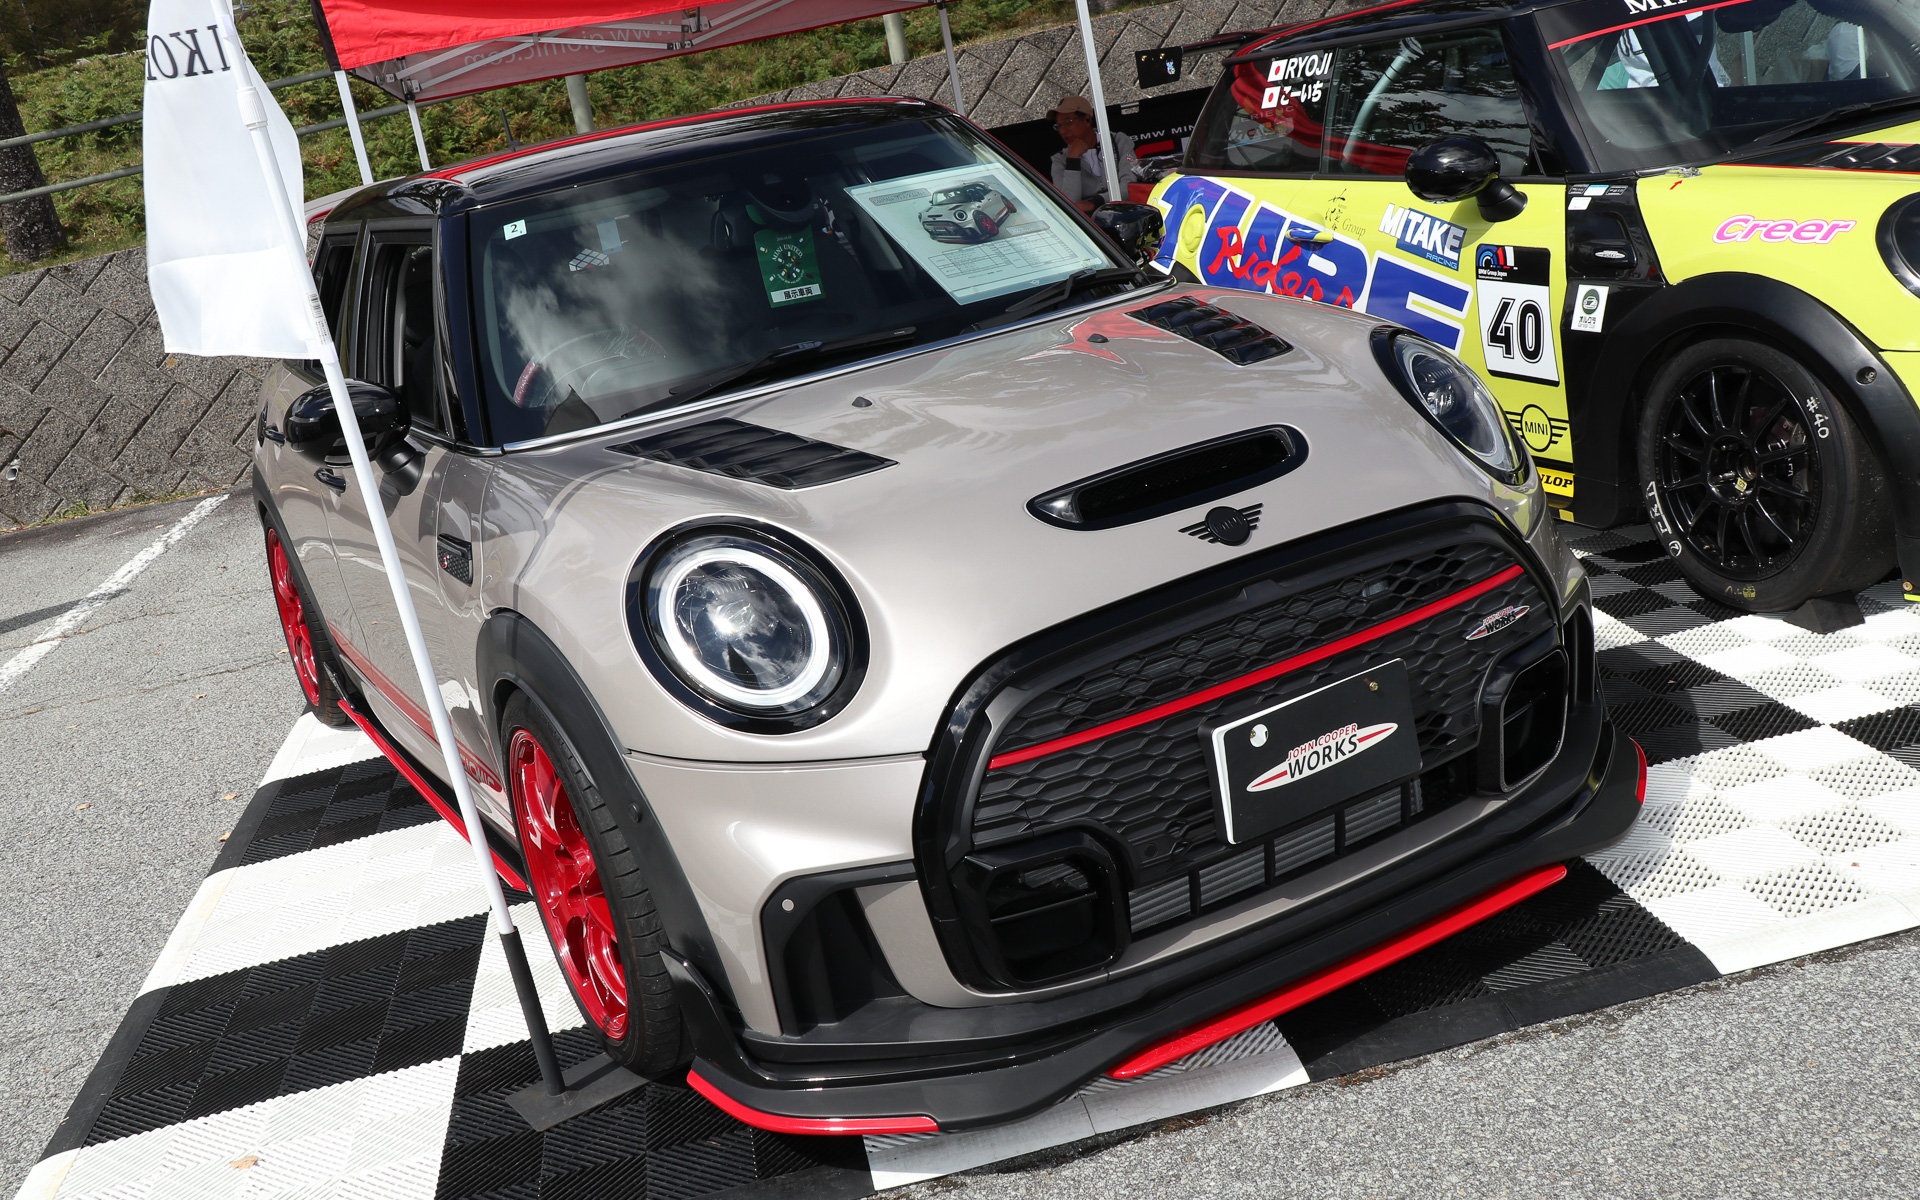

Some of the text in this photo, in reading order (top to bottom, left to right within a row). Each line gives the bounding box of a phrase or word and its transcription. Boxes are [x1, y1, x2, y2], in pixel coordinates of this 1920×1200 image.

[1285, 53, 1333, 80] RYOJI
[1280, 81, 1323, 105] こーいち
[1130, 130, 1165, 142] BMW
[510, 223, 519, 234] 2
[1342, 218, 1366, 240] Group
[1378, 203, 1464, 261] MITAKE
[1713, 214, 1857, 244] Creer
[772, 246, 783, 262] MINI
[1426, 252, 1458, 270] RACING
[783, 286, 813, 300] 展示車両
[1487, 297, 1544, 364] 40
[1525, 420, 1548, 436] MINI
[1806, 396, 1830, 439] #40
[1485, 611, 1517, 633] WORKS
[1287, 724, 1358, 762] JOHN COOPER
[1288, 734, 1358, 779] WORKS
